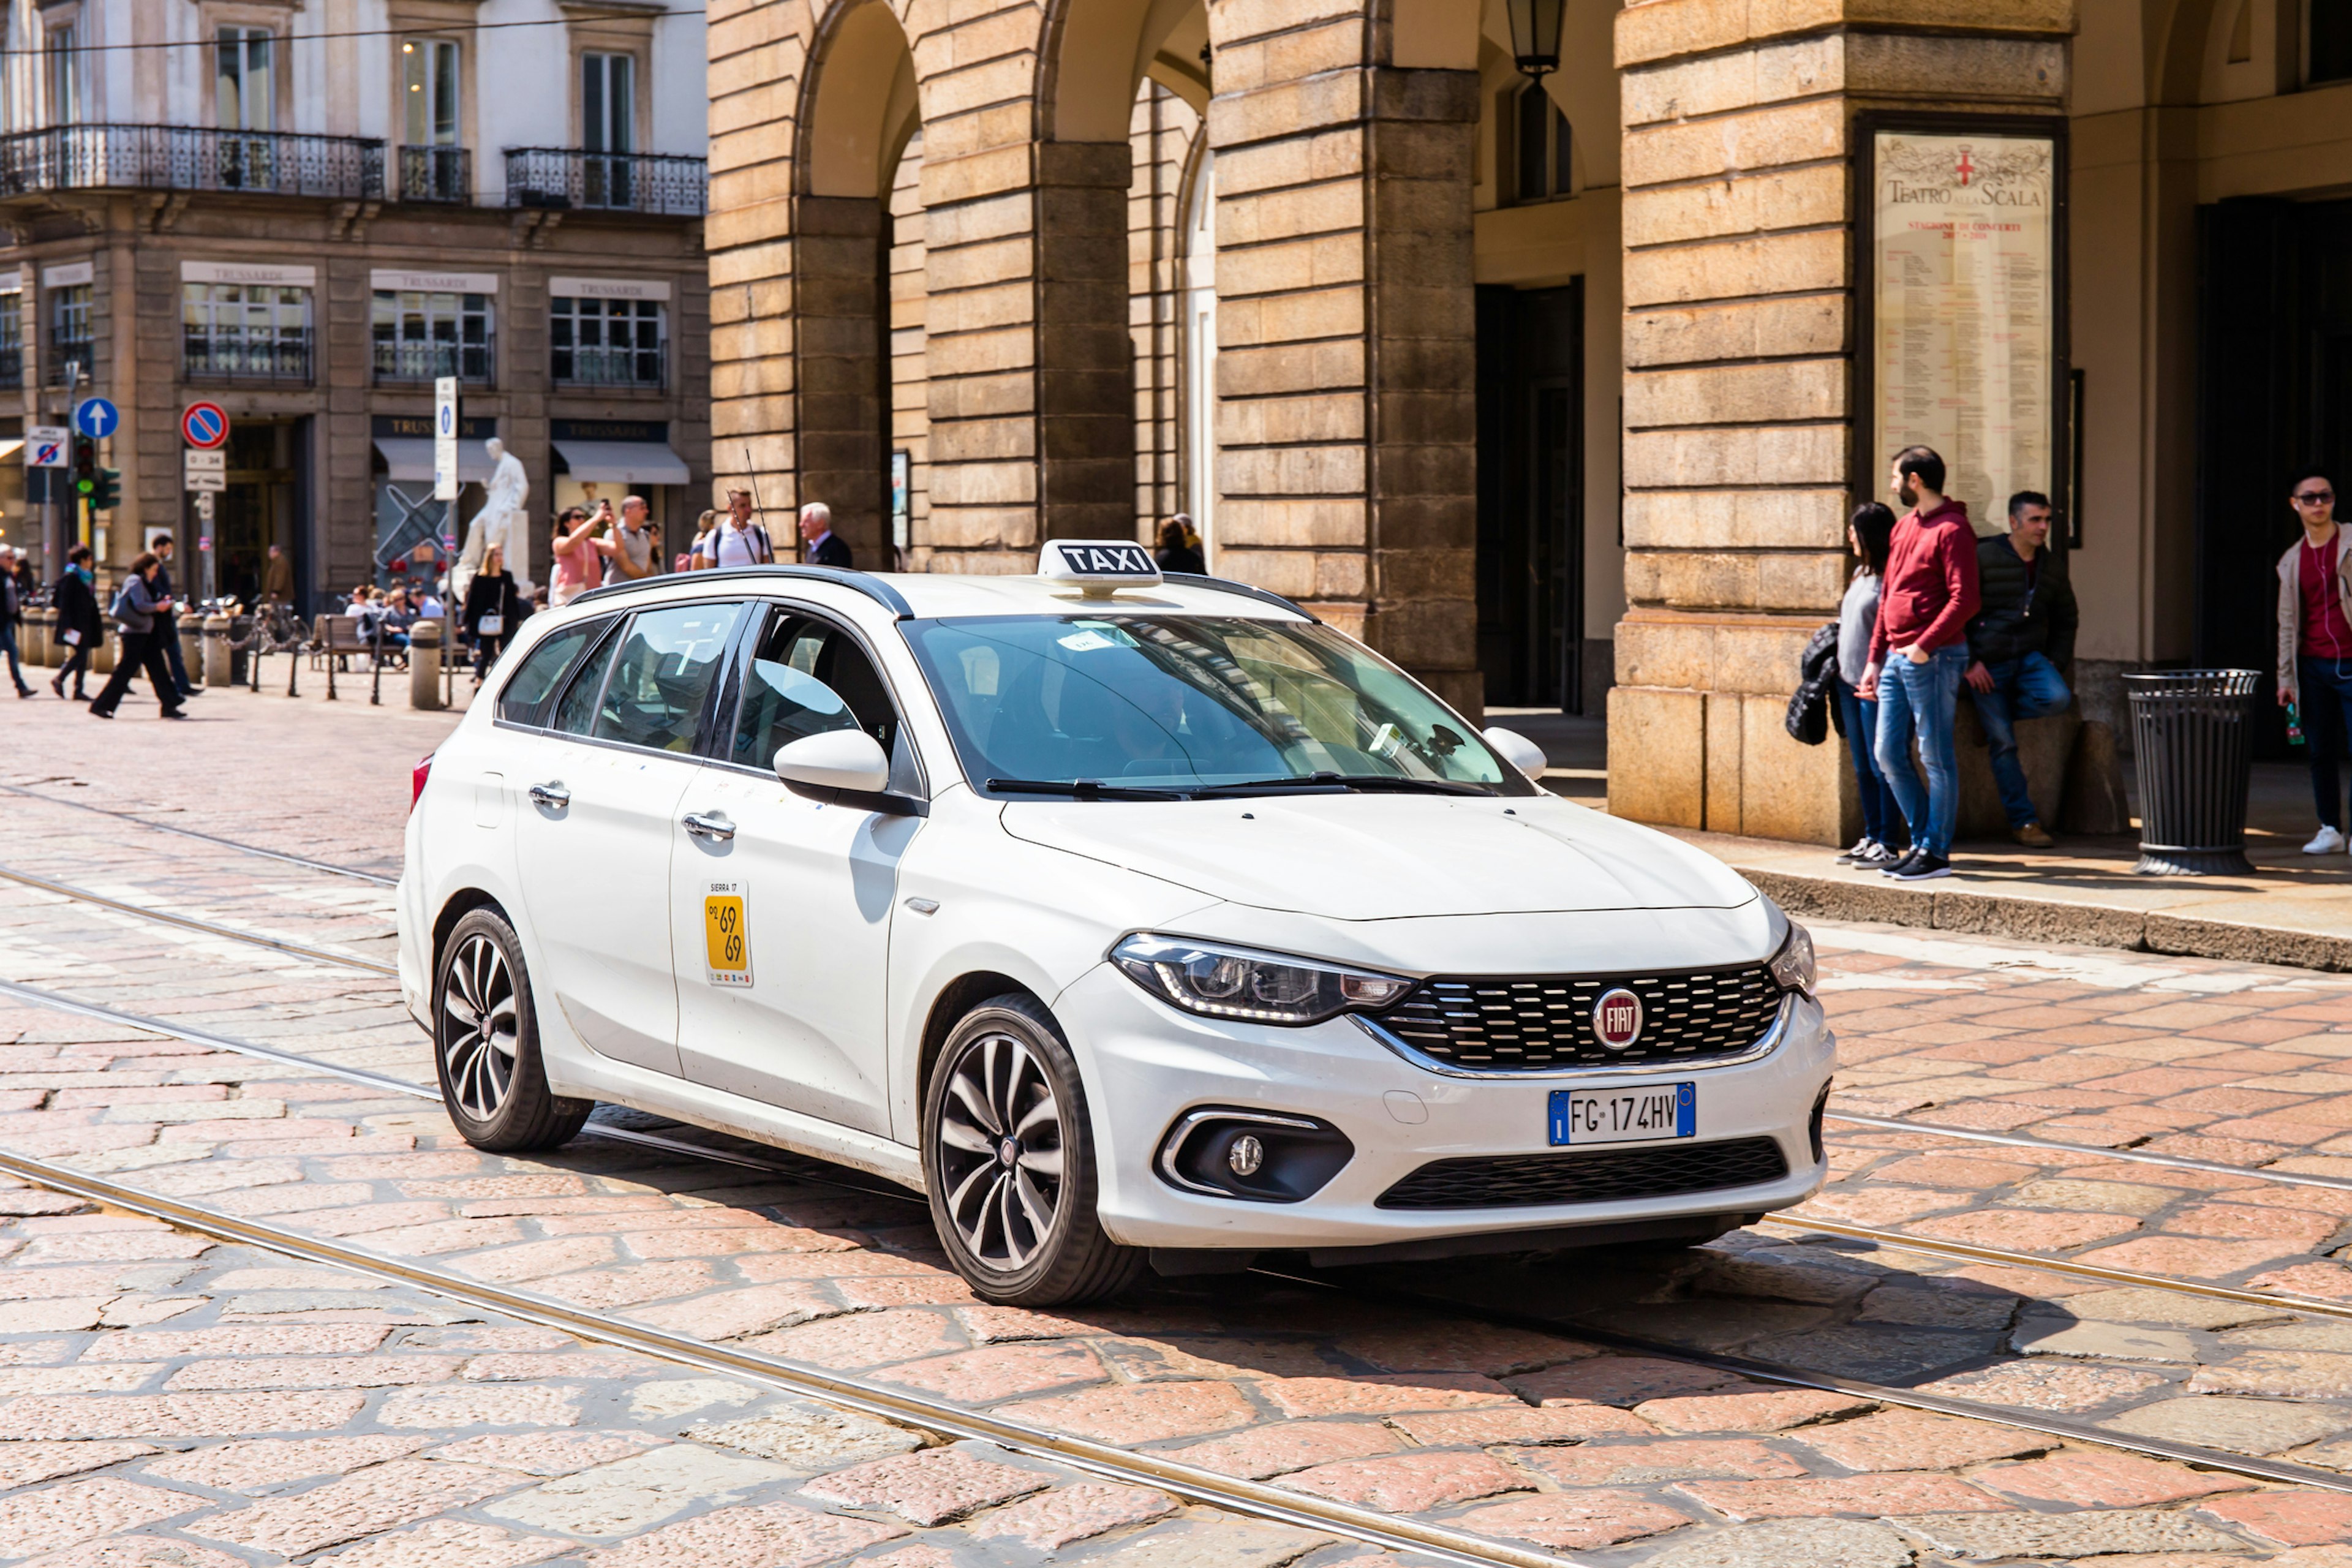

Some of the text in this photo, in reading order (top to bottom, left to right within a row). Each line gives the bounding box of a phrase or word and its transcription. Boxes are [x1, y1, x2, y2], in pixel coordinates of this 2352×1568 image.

[1888, 179, 2041, 207] TEATRO ALLA SCALA
[1908, 222, 1954, 230] STAGIONE
[1972, 223, 2021, 232] CONCERTI
[215, 268, 283, 281] TRUSSARDI
[402, 276, 467, 288] TRUSSARDI
[581, 284, 643, 297] TRUSSARDI
[392, 419, 475, 435] TRUSSDI
[1061, 548, 1150, 571] TAXI
[710, 883, 737, 892] SIERRA 17
[709, 906, 736, 933] 02 69
[725, 935, 741, 962] 69
[1606, 1006, 1634, 1033] FIAT
